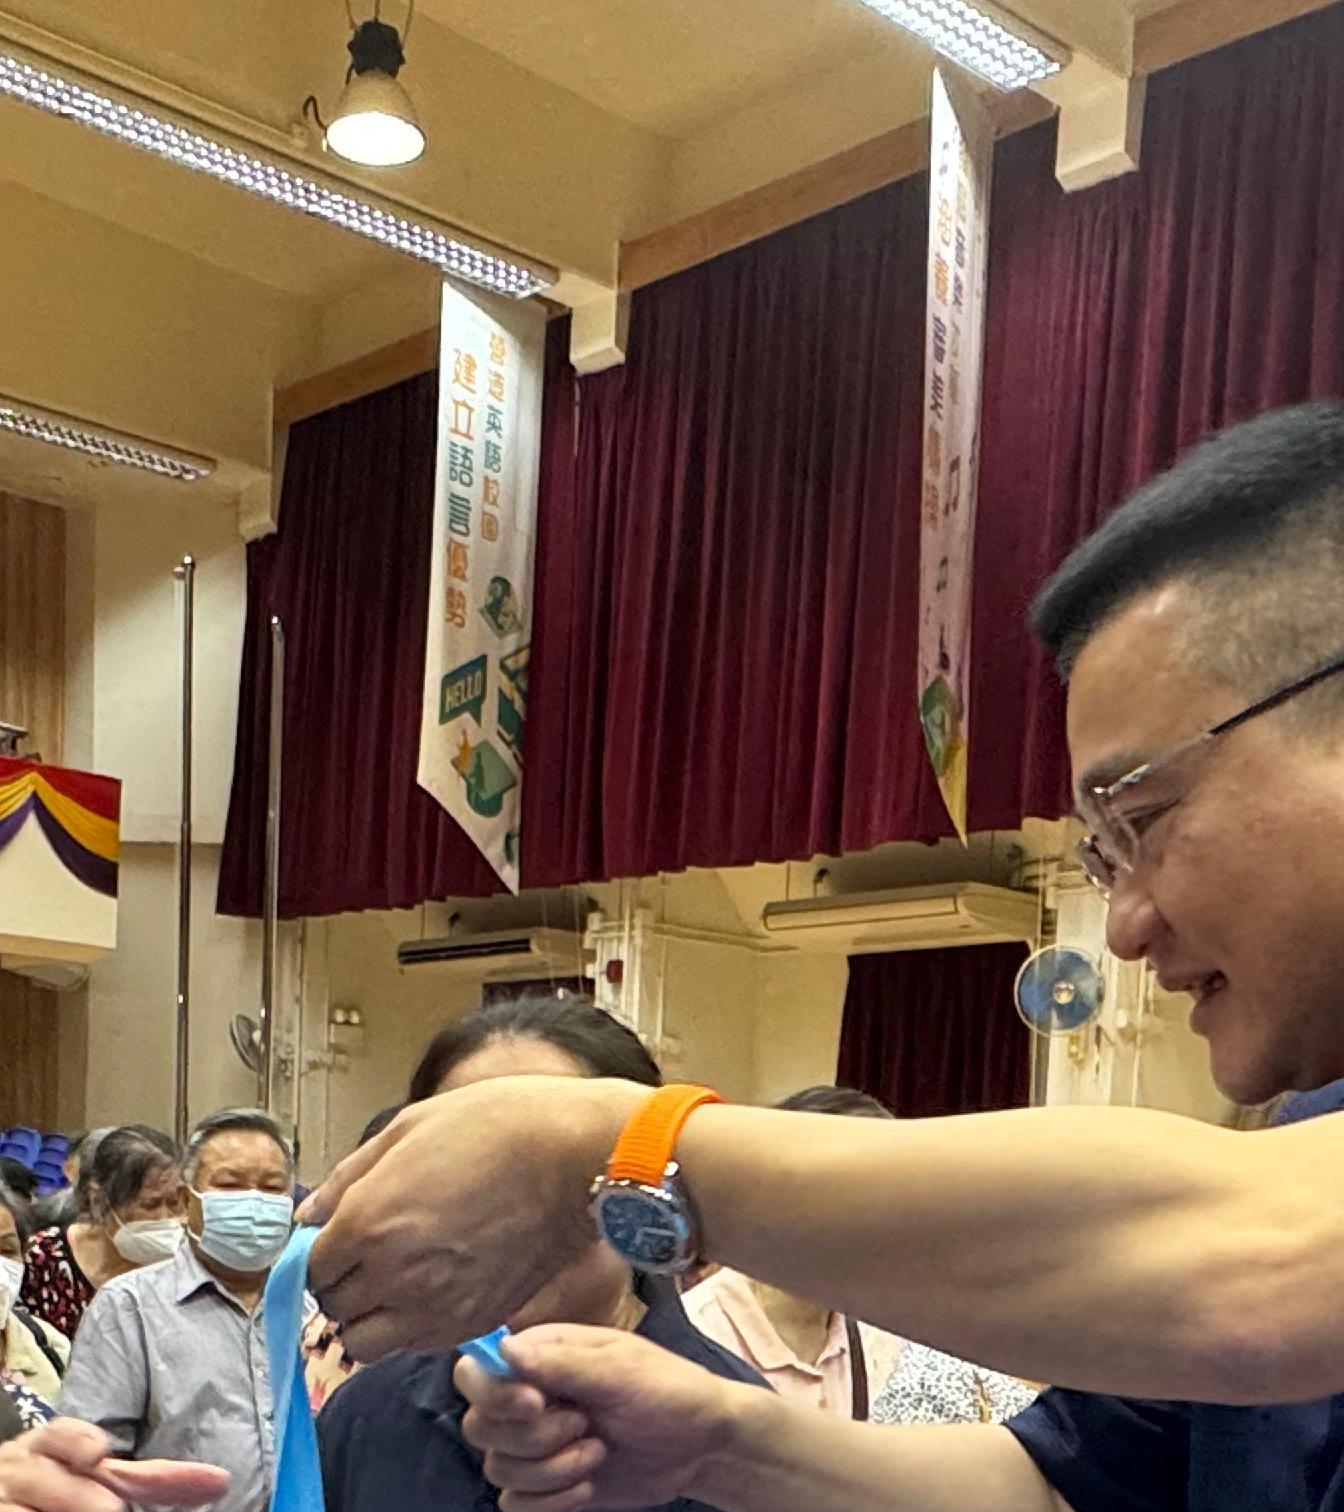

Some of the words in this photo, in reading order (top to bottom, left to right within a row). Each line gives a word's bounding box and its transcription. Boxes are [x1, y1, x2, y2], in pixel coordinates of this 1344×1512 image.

[444, 348, 478, 629] 建立語言優勢
[445, 669, 482, 713] HELLO
